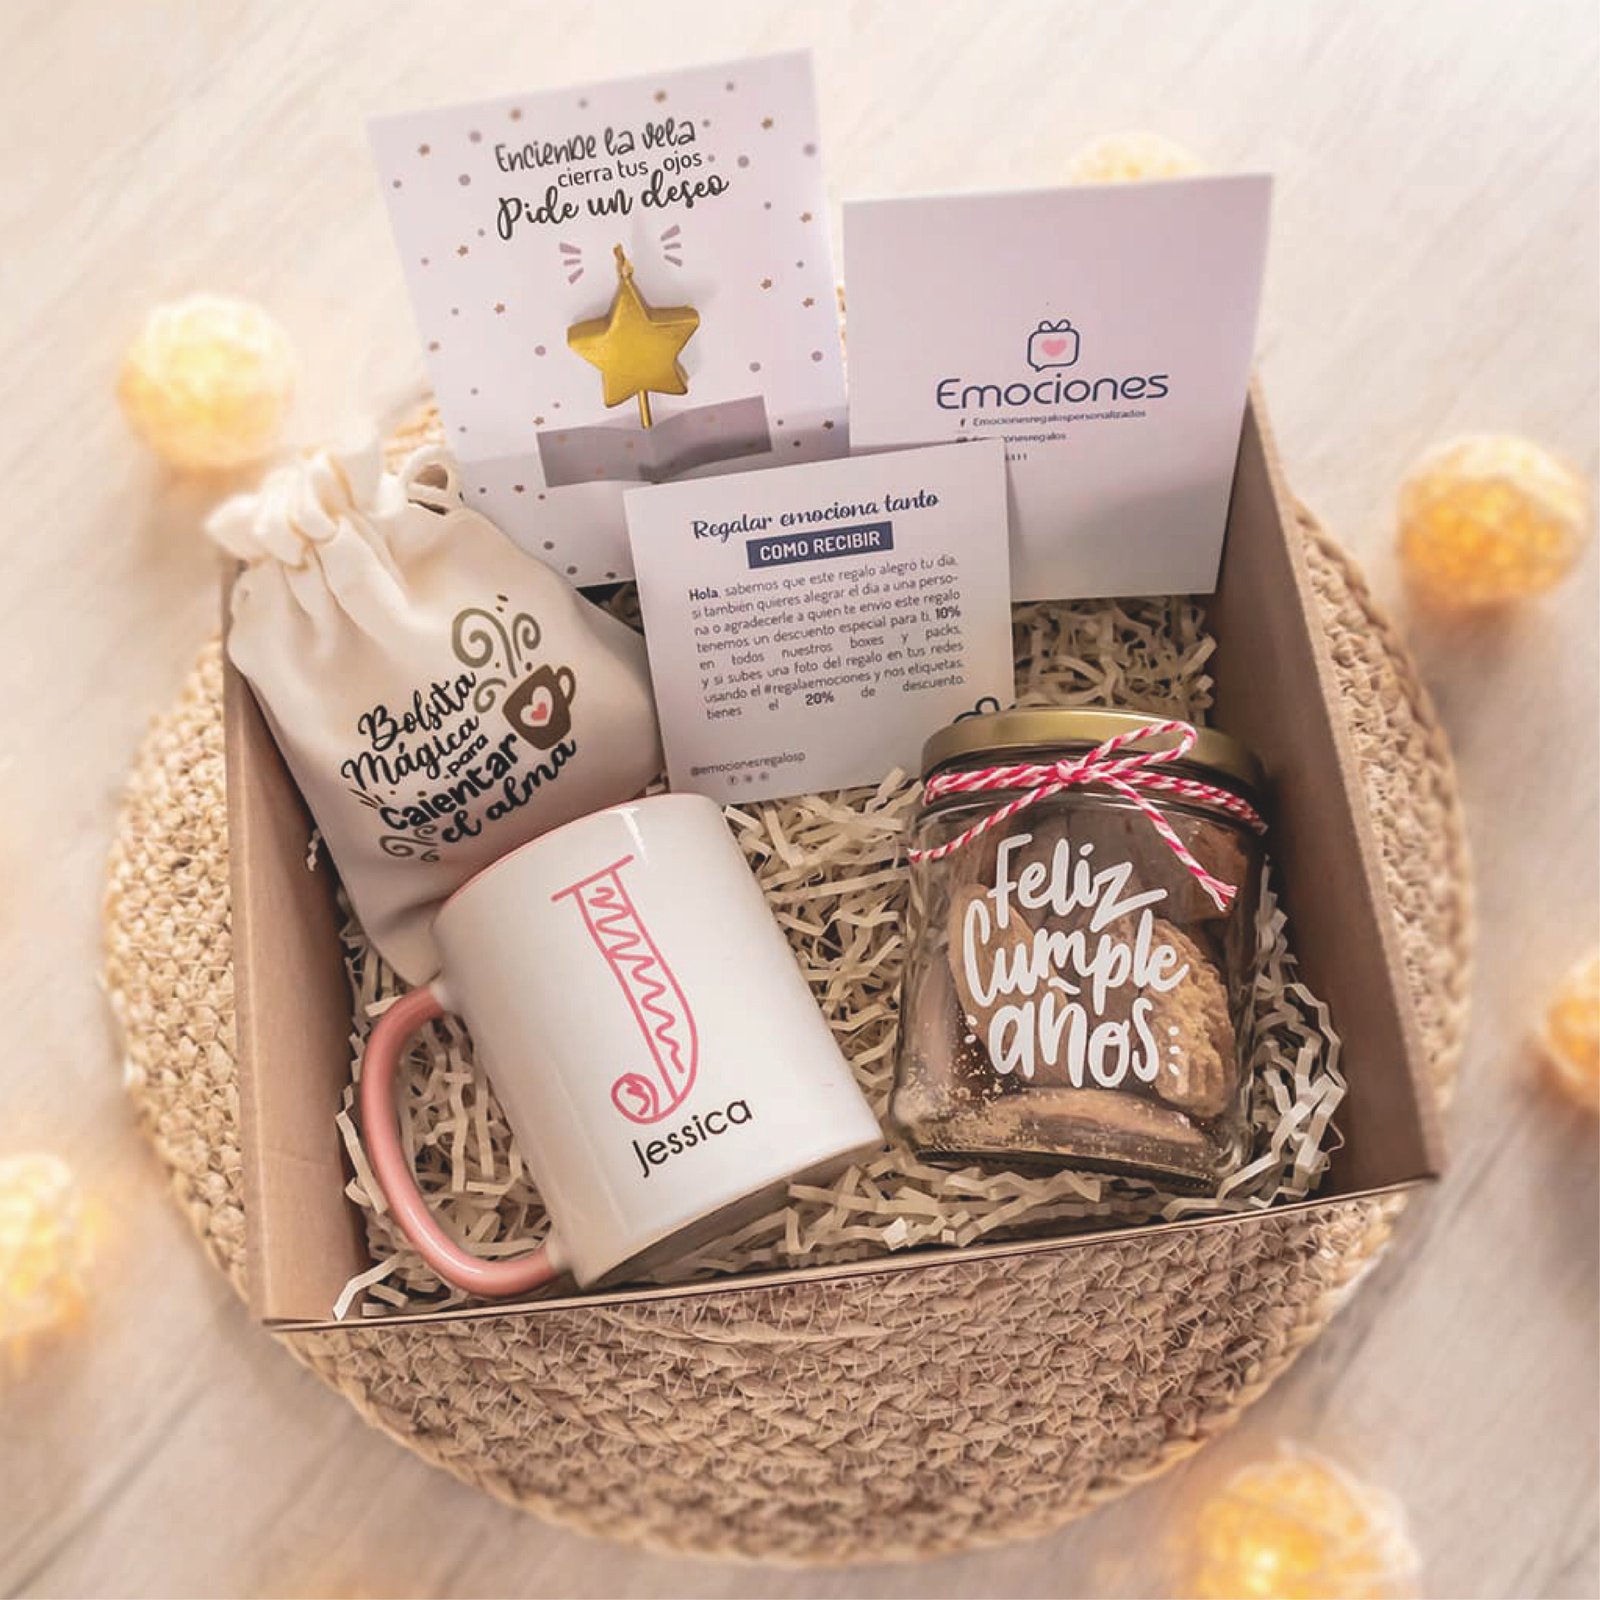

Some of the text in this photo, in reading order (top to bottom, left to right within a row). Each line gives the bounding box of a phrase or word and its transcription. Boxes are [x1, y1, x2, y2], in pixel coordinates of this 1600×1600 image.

[604, 126, 635, 156] la
[642, 117, 696, 150] vela
[558, 151, 702, 188] cierra tus ojos
[497, 168, 729, 240] Pide un deseo
[936, 373, 1169, 409] Emociones
[692, 489, 940, 543] Regalar emociona tanto
[759, 530, 881, 561] COMO RECIBIR
[724, 581, 778, 596] sabemos
[783, 576, 806, 590] que
[809, 572, 834, 585] este
[839, 565, 876, 582] regalo
[921, 557, 934, 568] tu
[757, 594, 801, 611] quieres
[803, 589, 844, 604] alegrar
[849, 585, 859, 597] el
[883, 584, 890, 592] a
[893, 579, 916, 591] una
[695, 625, 709, 636] na
[713, 624, 721, 634] o
[724, 611, 794, 635] agradecerle
[797, 613, 804, 621] a
[808, 607, 841, 622] quien
[844, 604, 856, 614] te
[895, 595, 920, 608] este
[924, 589, 960, 606] regalo
[697, 638, 750, 653] tenemos
[753, 634, 770, 646] un
[774, 625, 835, 642] descuento
[840, 615, 886, 634] especial
[890, 614, 917, 628] para
[935, 605, 961, 620] 10%
[700, 660, 715, 671] en
[731, 651, 764, 666] todos
[781, 643, 833, 659] nuestros
[850, 636, 884, 649] boxes
[901, 633, 909, 644] y
[701, 639, 963, 690] y si subes una foto del regalo en tus redes
[704, 686, 748, 703] usando
[750, 684, 760, 697] el
[764, 672, 871, 696] #regalaemociones
[874, 670, 881, 683] y
[884, 667, 905, 678] nos
[707, 706, 742, 720] tienes
[768, 698, 779, 711] el
[805, 690, 834, 707] 20%
[861, 685, 876, 698] de
[357, 671, 476, 751] Bolsita
[340, 716, 480, 791] Mágica
[447, 734, 489, 777] para
[442, 739, 576, 843] el alma
[987, 833, 1168, 933] Feliz
[964, 909, 1189, 1016] Cumple
[989, 976, 1160, 1088] años
[632, 1098, 753, 1178] Jessica
